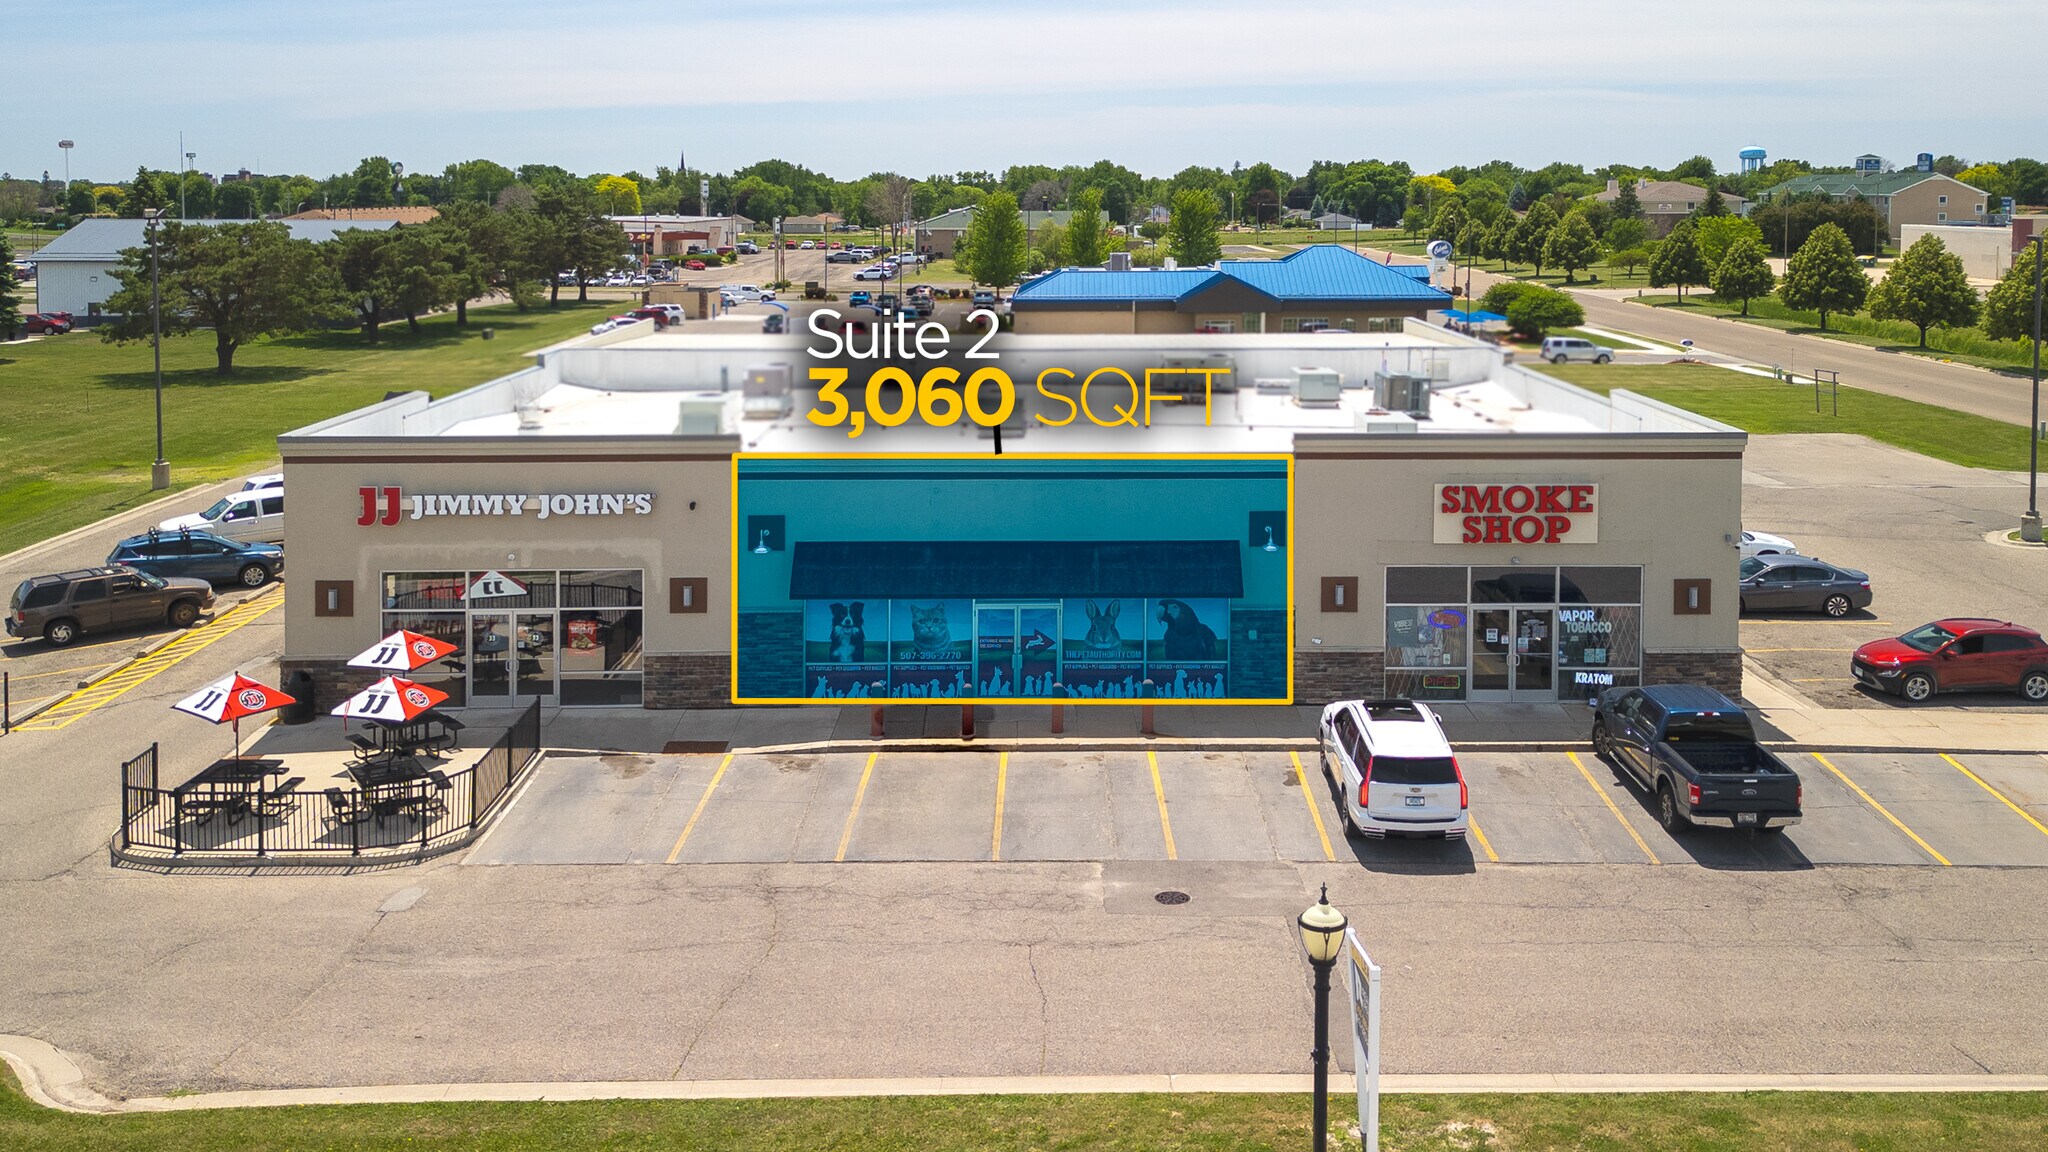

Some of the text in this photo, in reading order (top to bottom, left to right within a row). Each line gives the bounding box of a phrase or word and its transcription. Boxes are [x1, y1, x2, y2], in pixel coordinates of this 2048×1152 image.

[356, 486, 652, 527] JJ JIMMY JOHN'S
[1442, 485, 1594, 513] SMOKE
[1463, 515, 1571, 543] SHOP
[1559, 609, 1595, 622] VAPOR
[1565, 621, 1612, 633] TOBACCO
[371, 647, 399, 665] JJ
[1064, 650, 1142, 659] THEPETAUTHORITY.COM
[1426, 676, 1457, 686] PIPES
[1575, 672, 1613, 685] KRATOM
[194, 690, 223, 711] JJ
[358, 694, 390, 714] JJ
